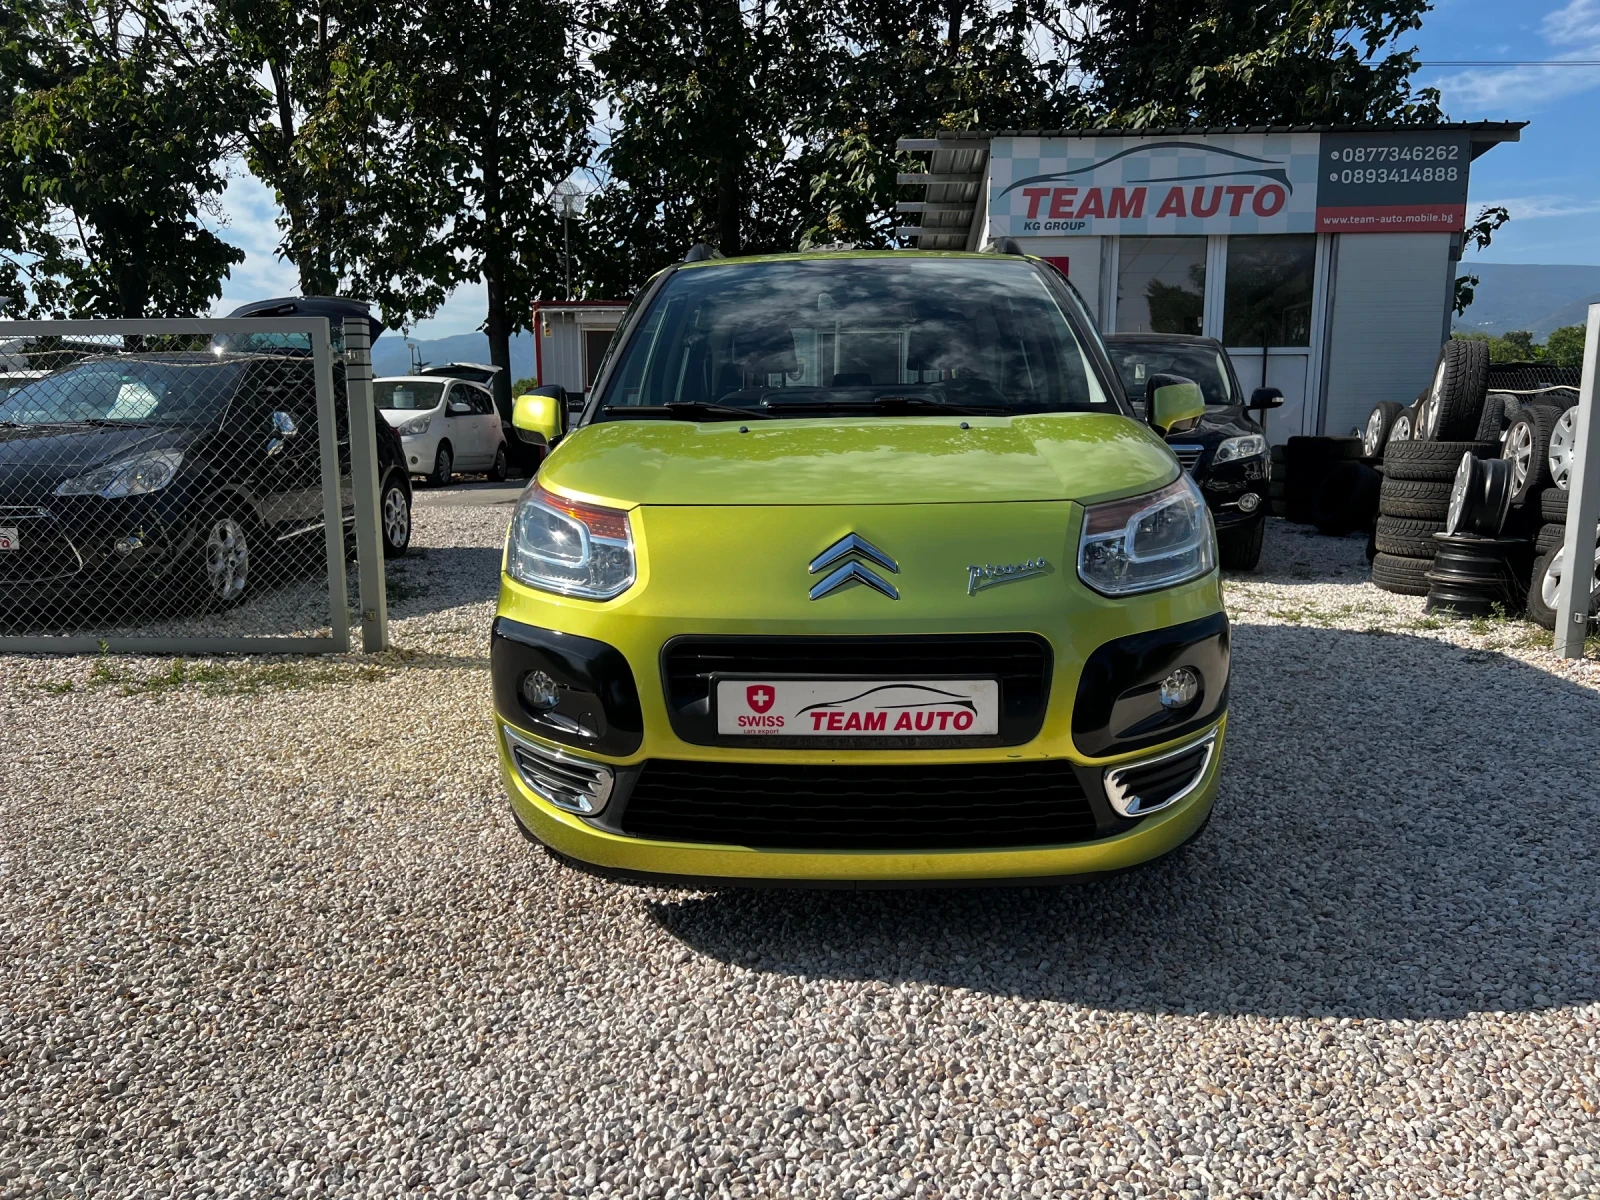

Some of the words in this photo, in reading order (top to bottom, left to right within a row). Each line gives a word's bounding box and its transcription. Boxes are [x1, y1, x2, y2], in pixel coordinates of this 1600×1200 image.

[1342, 145, 1459, 162] 0877346262
[1341, 166, 1458, 184] 0893414888
[1022, 187, 1147, 219] TEAM
[1155, 184, 1286, 218] AUTO
[1023, 221, 1041, 231] KG
[1043, 221, 1086, 231] GROUP
[1323, 212, 1453, 225] www.team-auto.mobile.bg
[737, 715, 785, 727] SWISS
[809, 711, 887, 731] TEAM
[893, 710, 974, 731] AUTO
[757, 728, 779, 736] export
